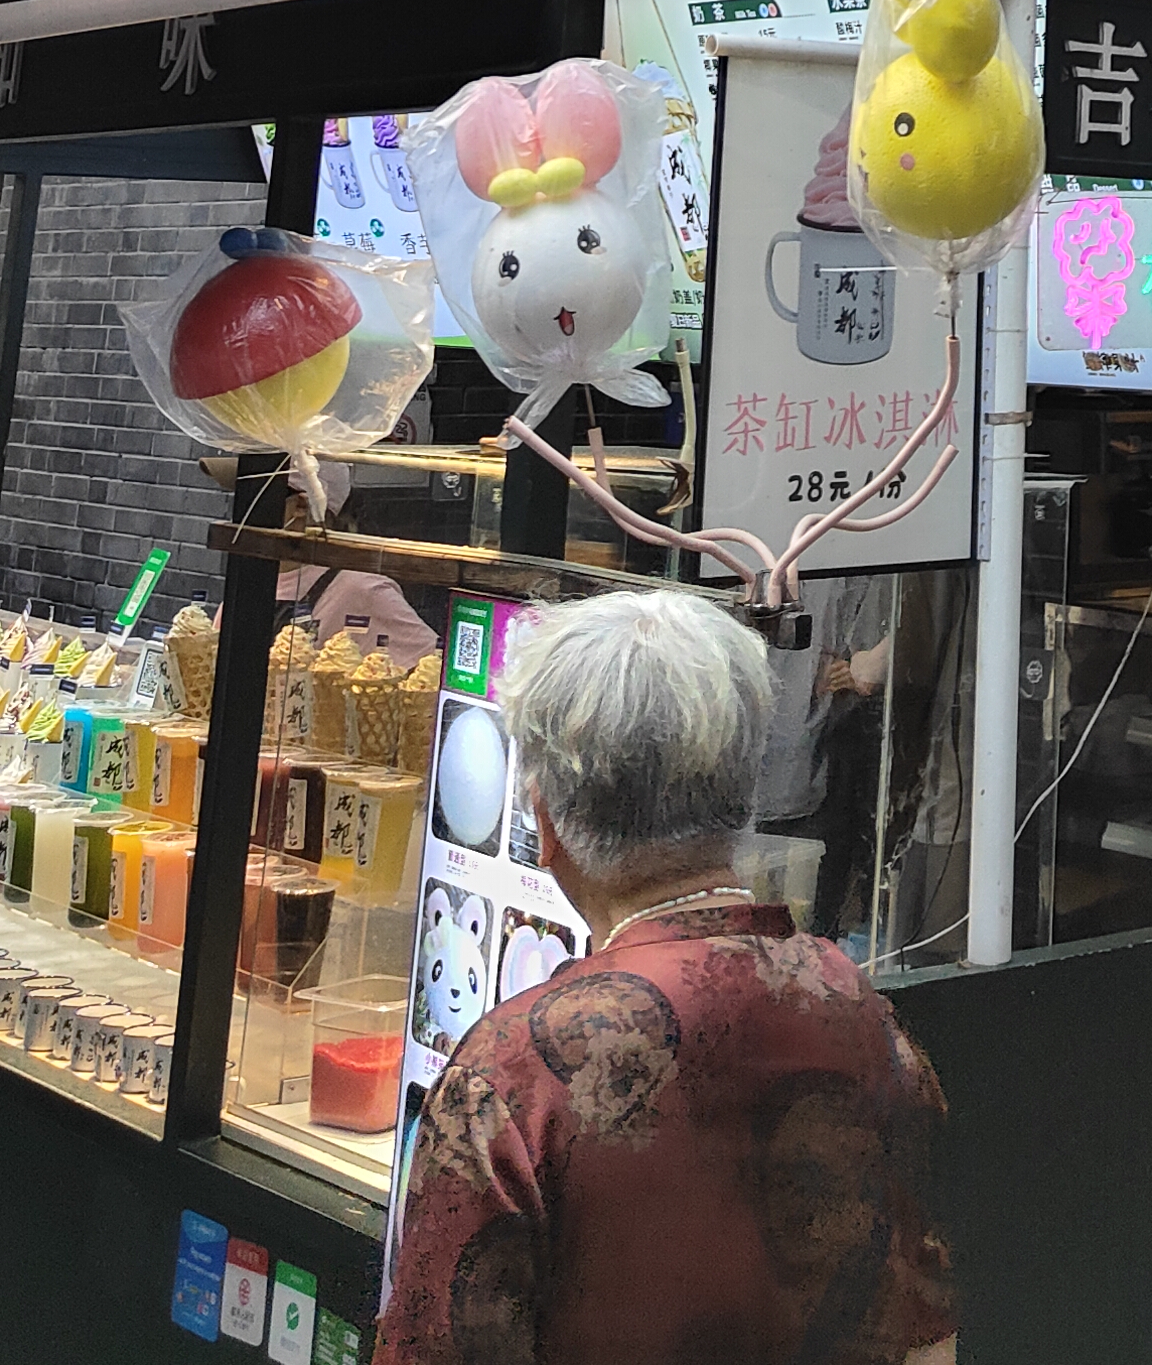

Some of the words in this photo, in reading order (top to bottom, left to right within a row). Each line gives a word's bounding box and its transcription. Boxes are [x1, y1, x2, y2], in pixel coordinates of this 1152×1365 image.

[692, 3, 725, 23] 奶茶
[341, 232, 376, 252] 草莓
[723, 390, 959, 457] 茶缸冰淇淋
